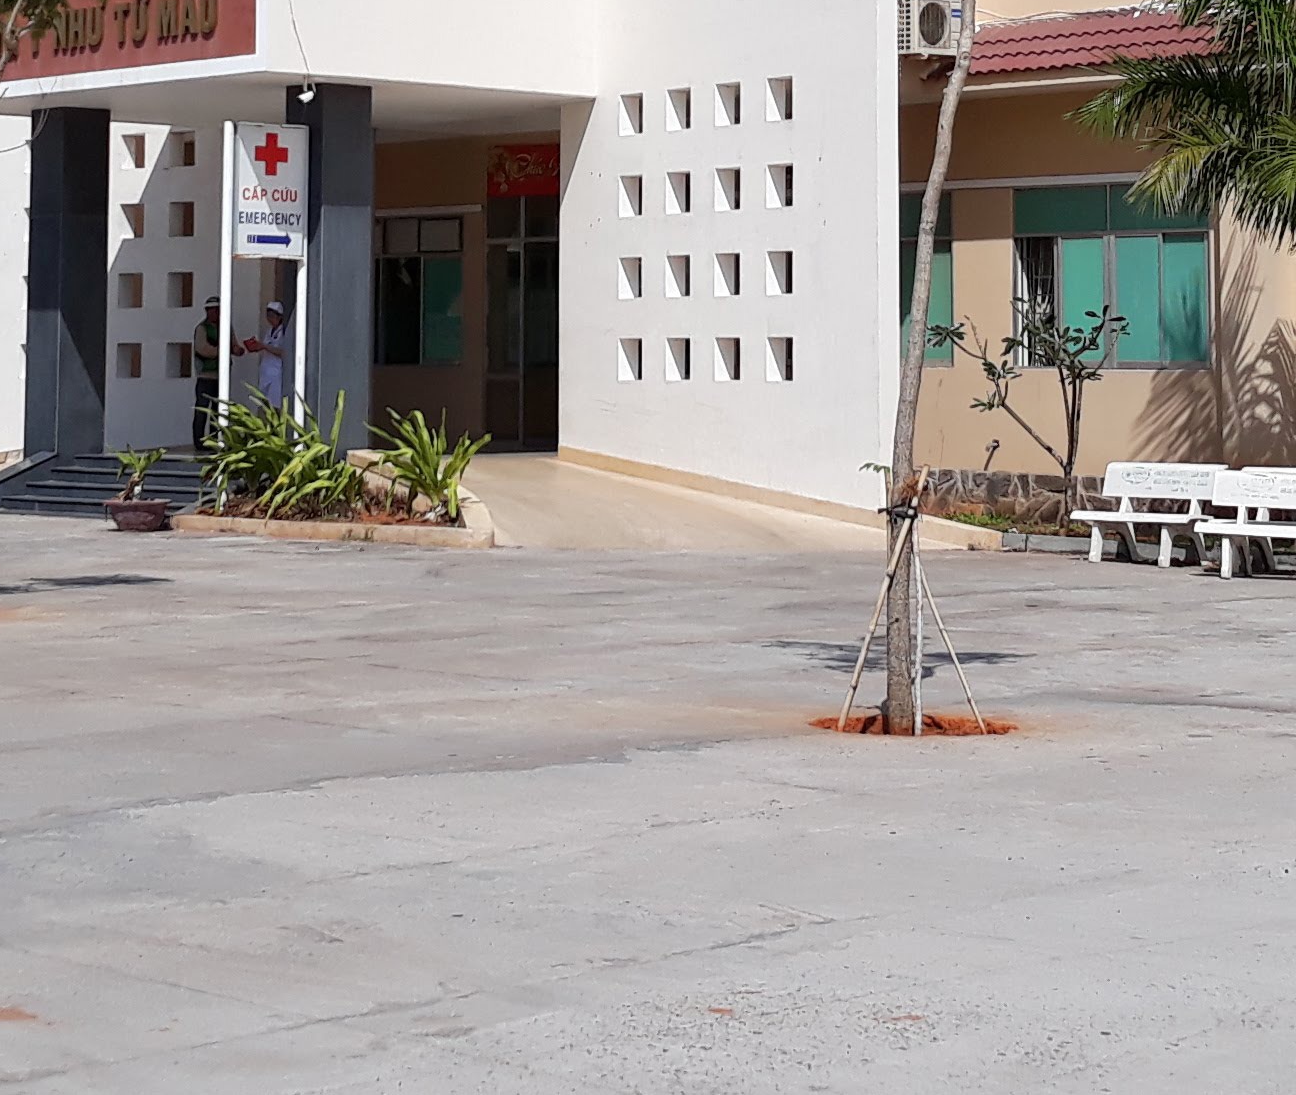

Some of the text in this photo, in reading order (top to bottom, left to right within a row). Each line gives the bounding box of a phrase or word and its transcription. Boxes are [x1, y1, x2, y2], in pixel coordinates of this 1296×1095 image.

[242, 184, 298, 203] CẤP CỨU
[238, 211, 302, 226] EMERGENCY
